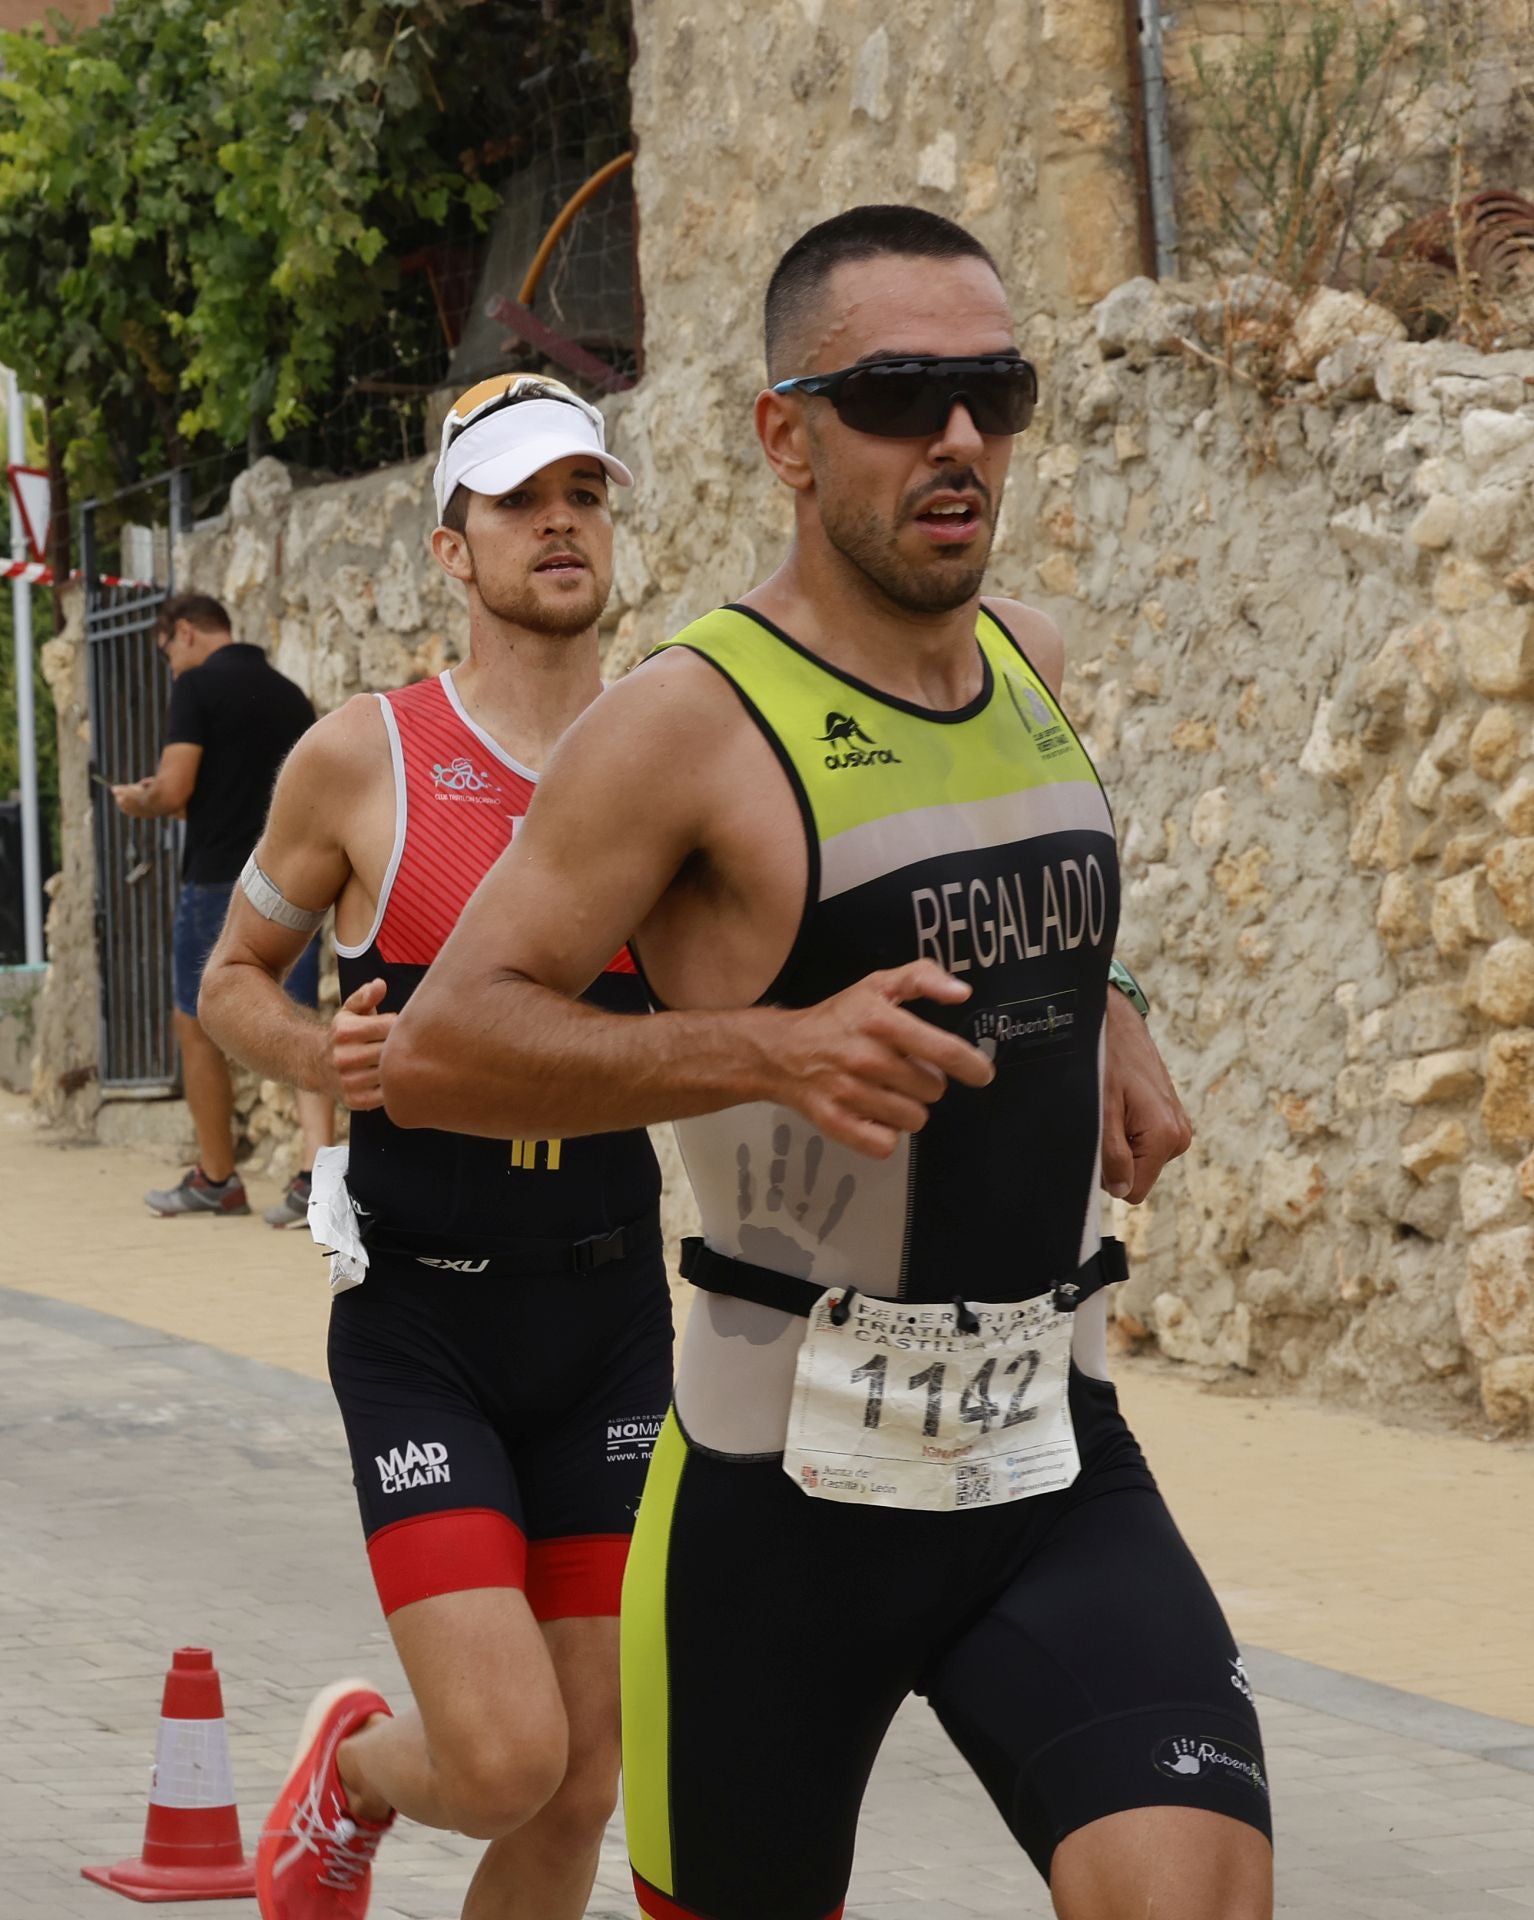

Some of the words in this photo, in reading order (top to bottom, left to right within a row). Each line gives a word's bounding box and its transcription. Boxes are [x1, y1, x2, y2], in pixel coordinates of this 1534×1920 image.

[911, 854, 1106, 973] REGALADO
[416, 1256, 490, 1273] 2XU
[850, 1349, 1041, 1438] 1142
[375, 1440, 449, 1482] MAD
